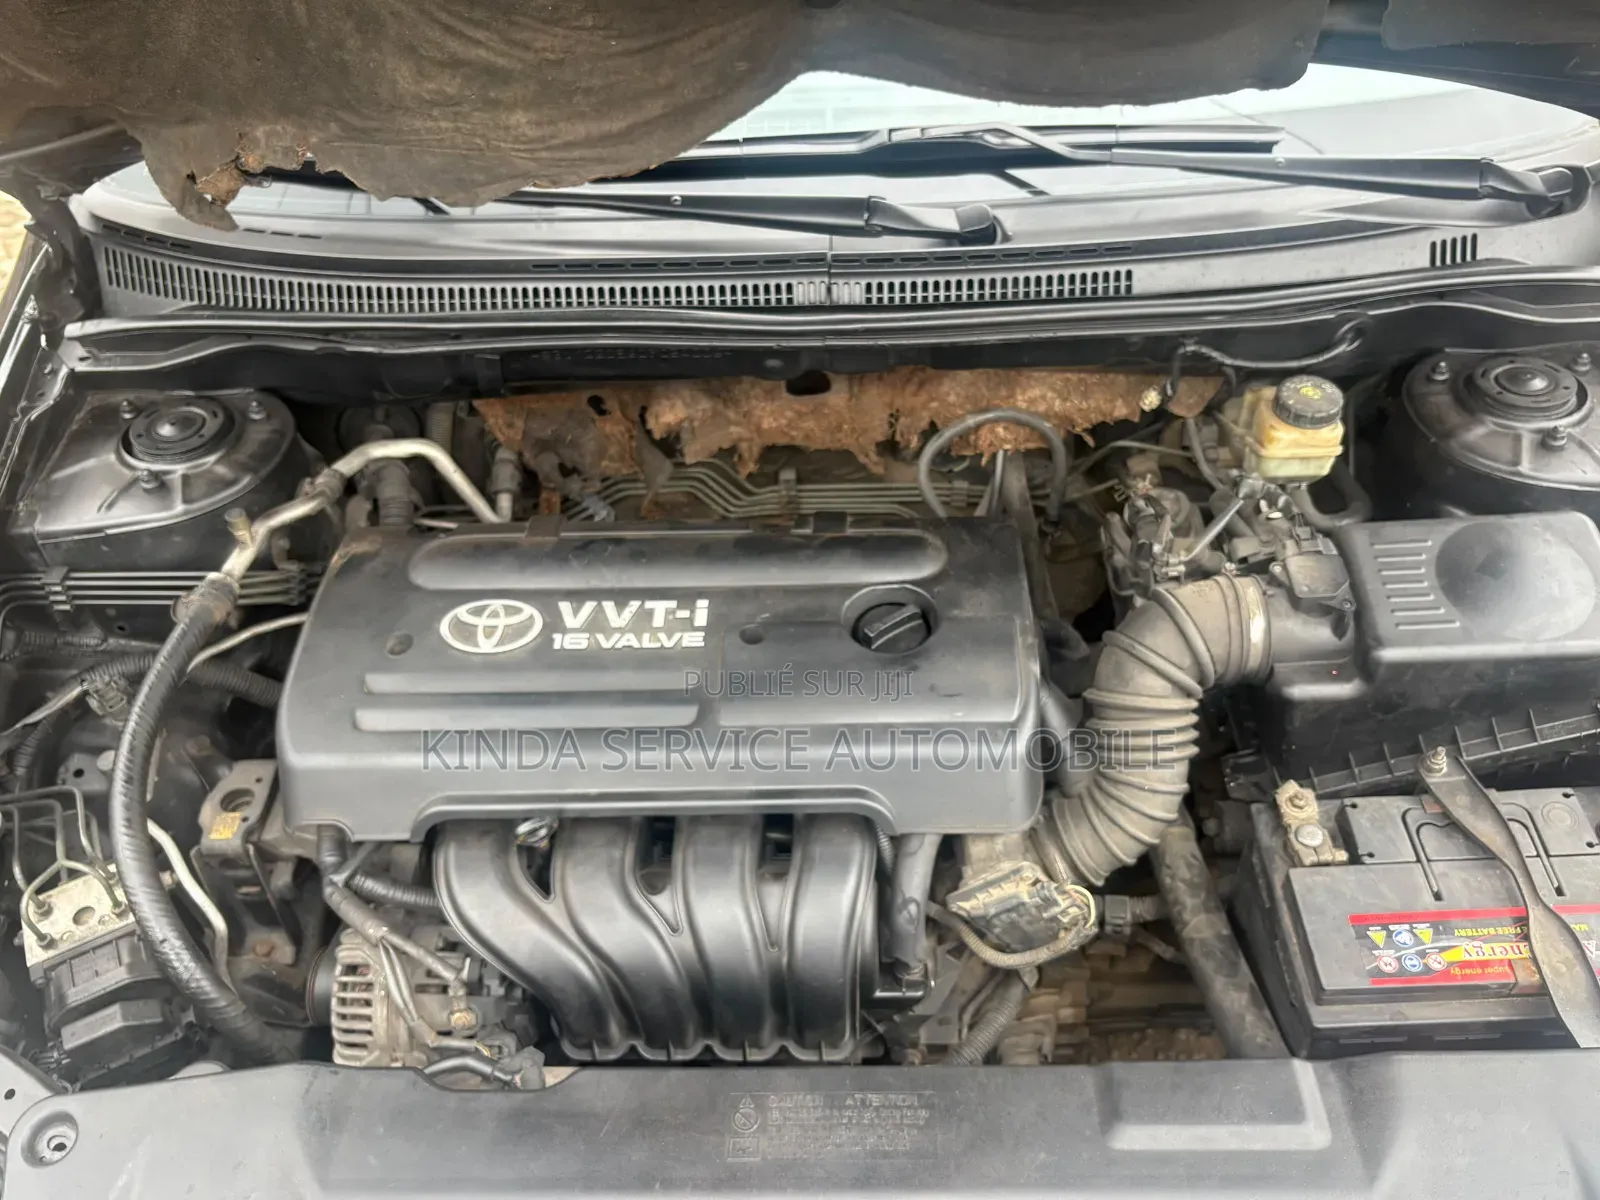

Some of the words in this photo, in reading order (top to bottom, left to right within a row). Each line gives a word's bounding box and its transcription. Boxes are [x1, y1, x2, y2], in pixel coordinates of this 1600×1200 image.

[558, 599, 709, 629] VVT-i
[552, 632, 590, 650] 16
[595, 631, 705, 649] VALVE
[1454, 927, 1495, 937] BATTERY
[1450, 966, 1482, 976] energy
